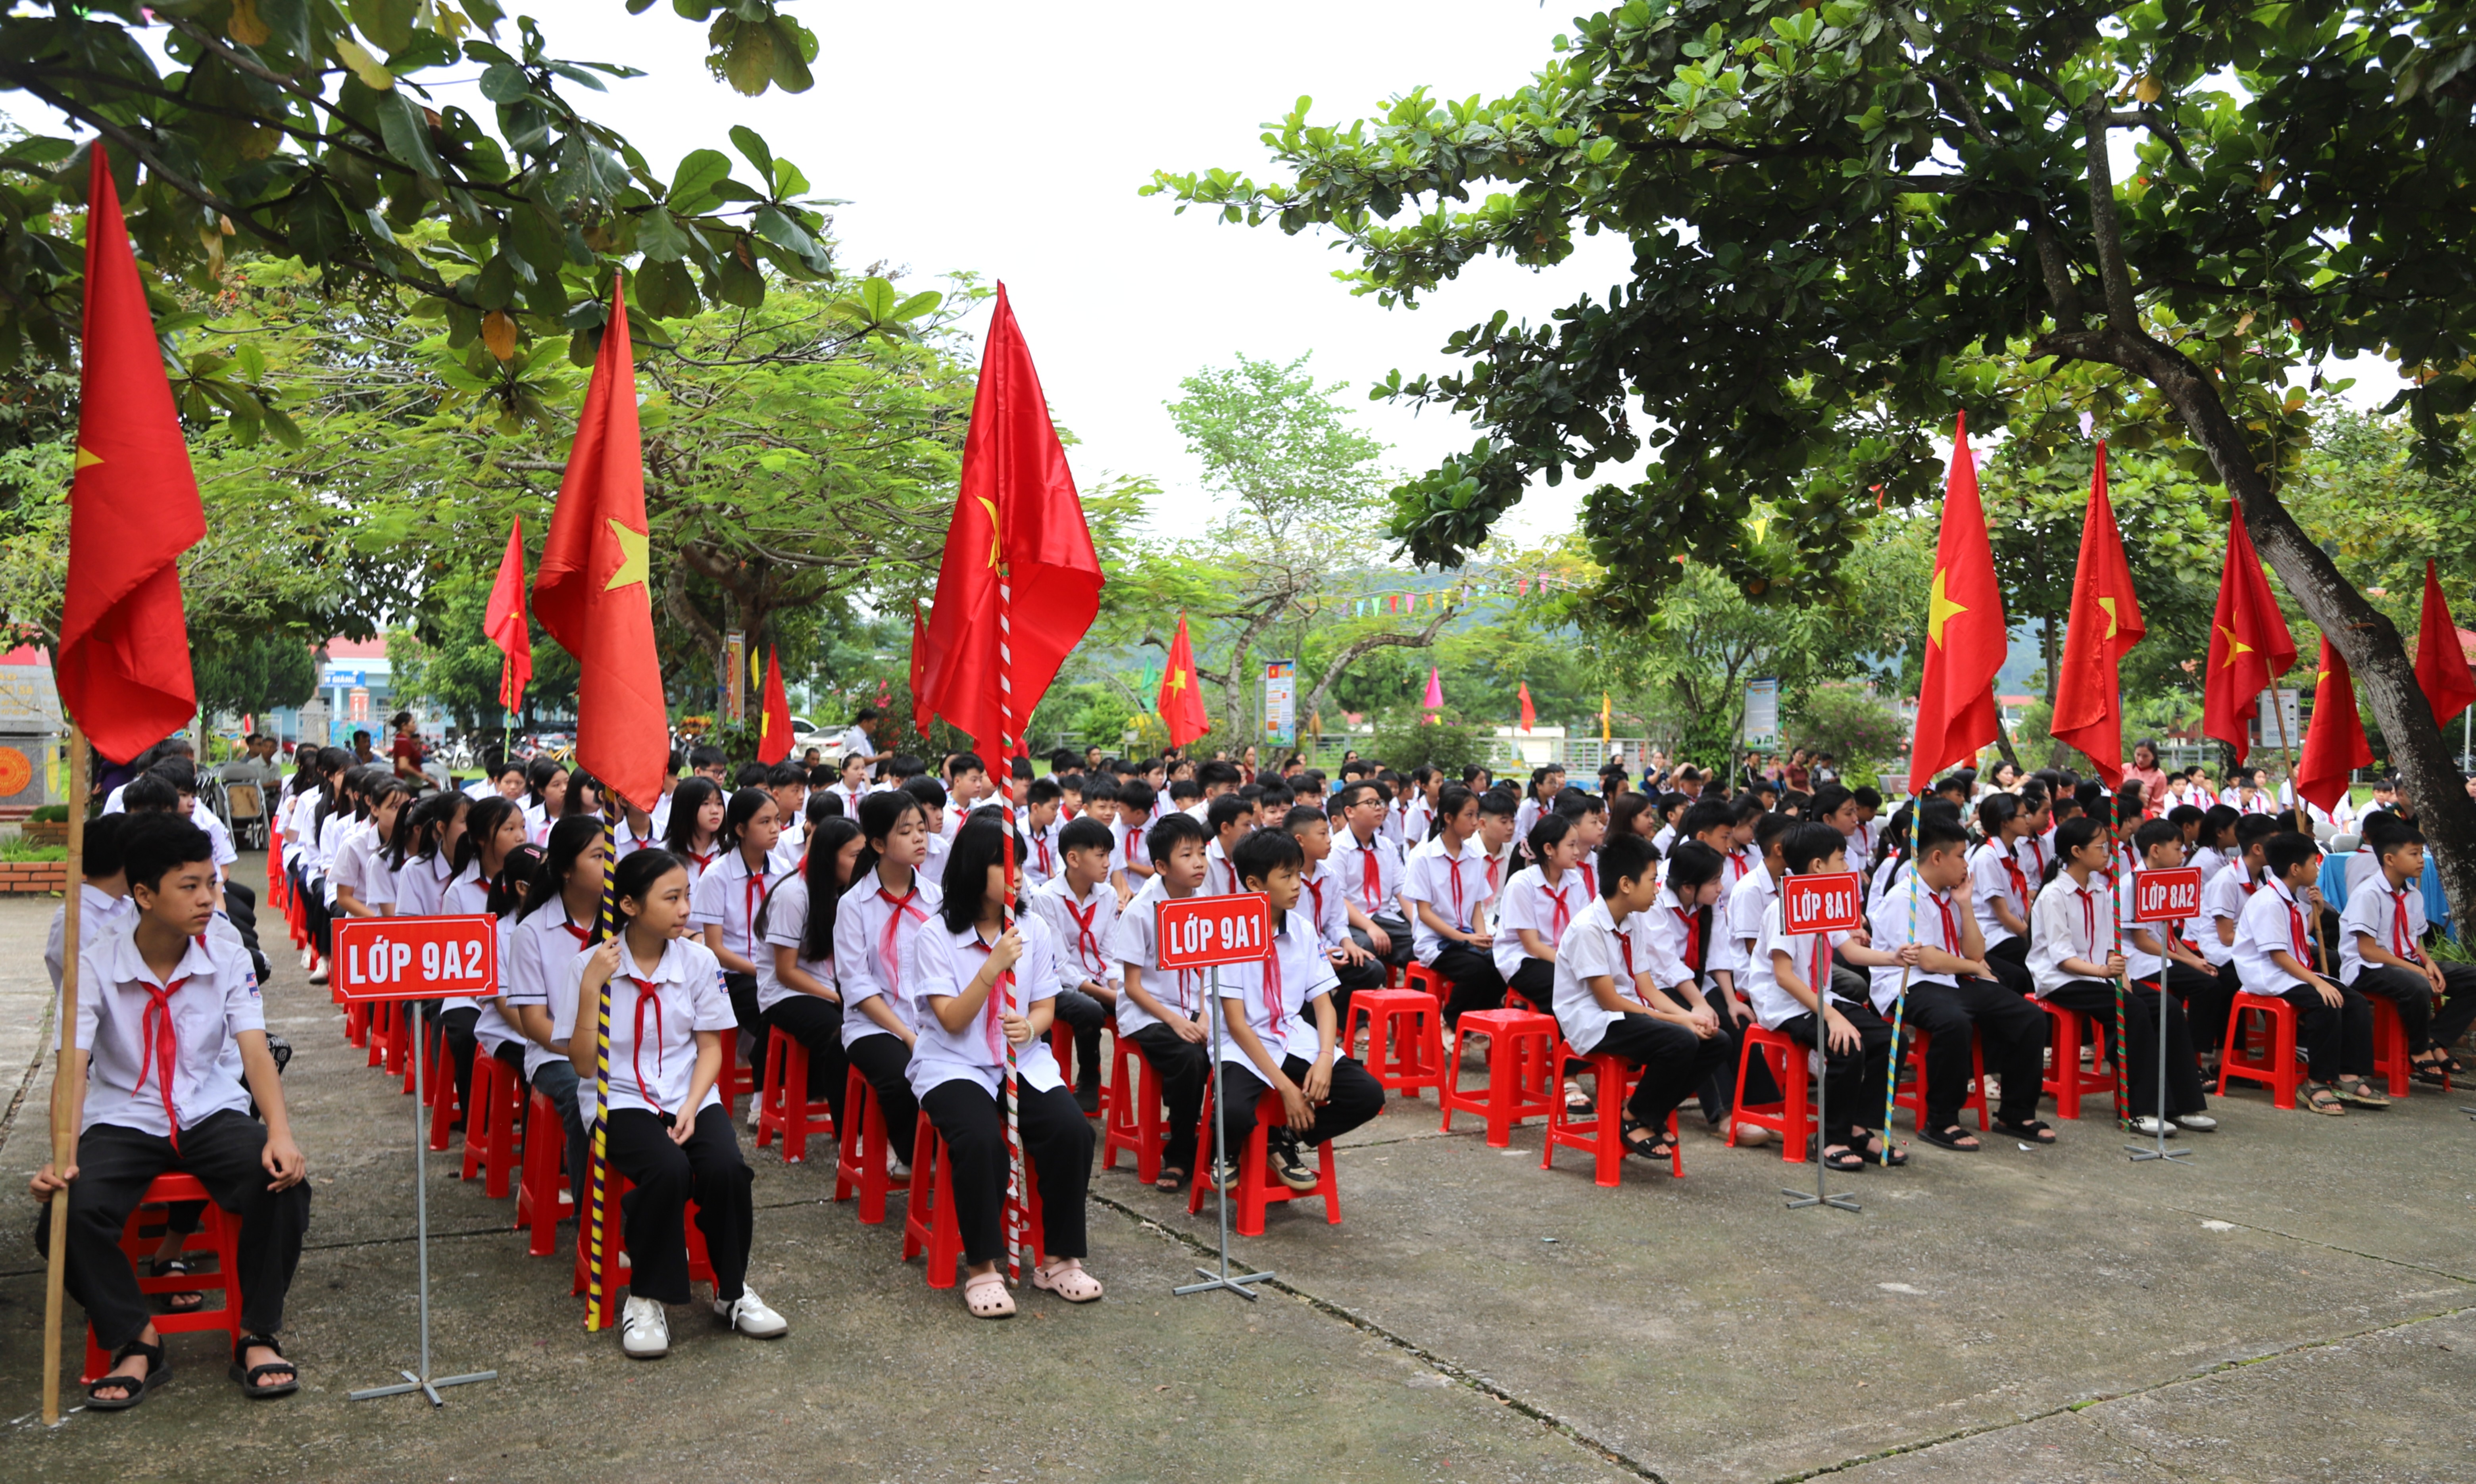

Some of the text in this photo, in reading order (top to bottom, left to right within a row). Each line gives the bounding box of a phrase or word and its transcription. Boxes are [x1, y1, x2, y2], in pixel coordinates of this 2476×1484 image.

[1792, 888, 1852, 923] LỚP 8A1
[2141, 880, 2195, 911] LỚP 8A2
[1171, 913, 1260, 955] LỚP 9A1
[350, 935, 483, 984] LỚP 9A2
